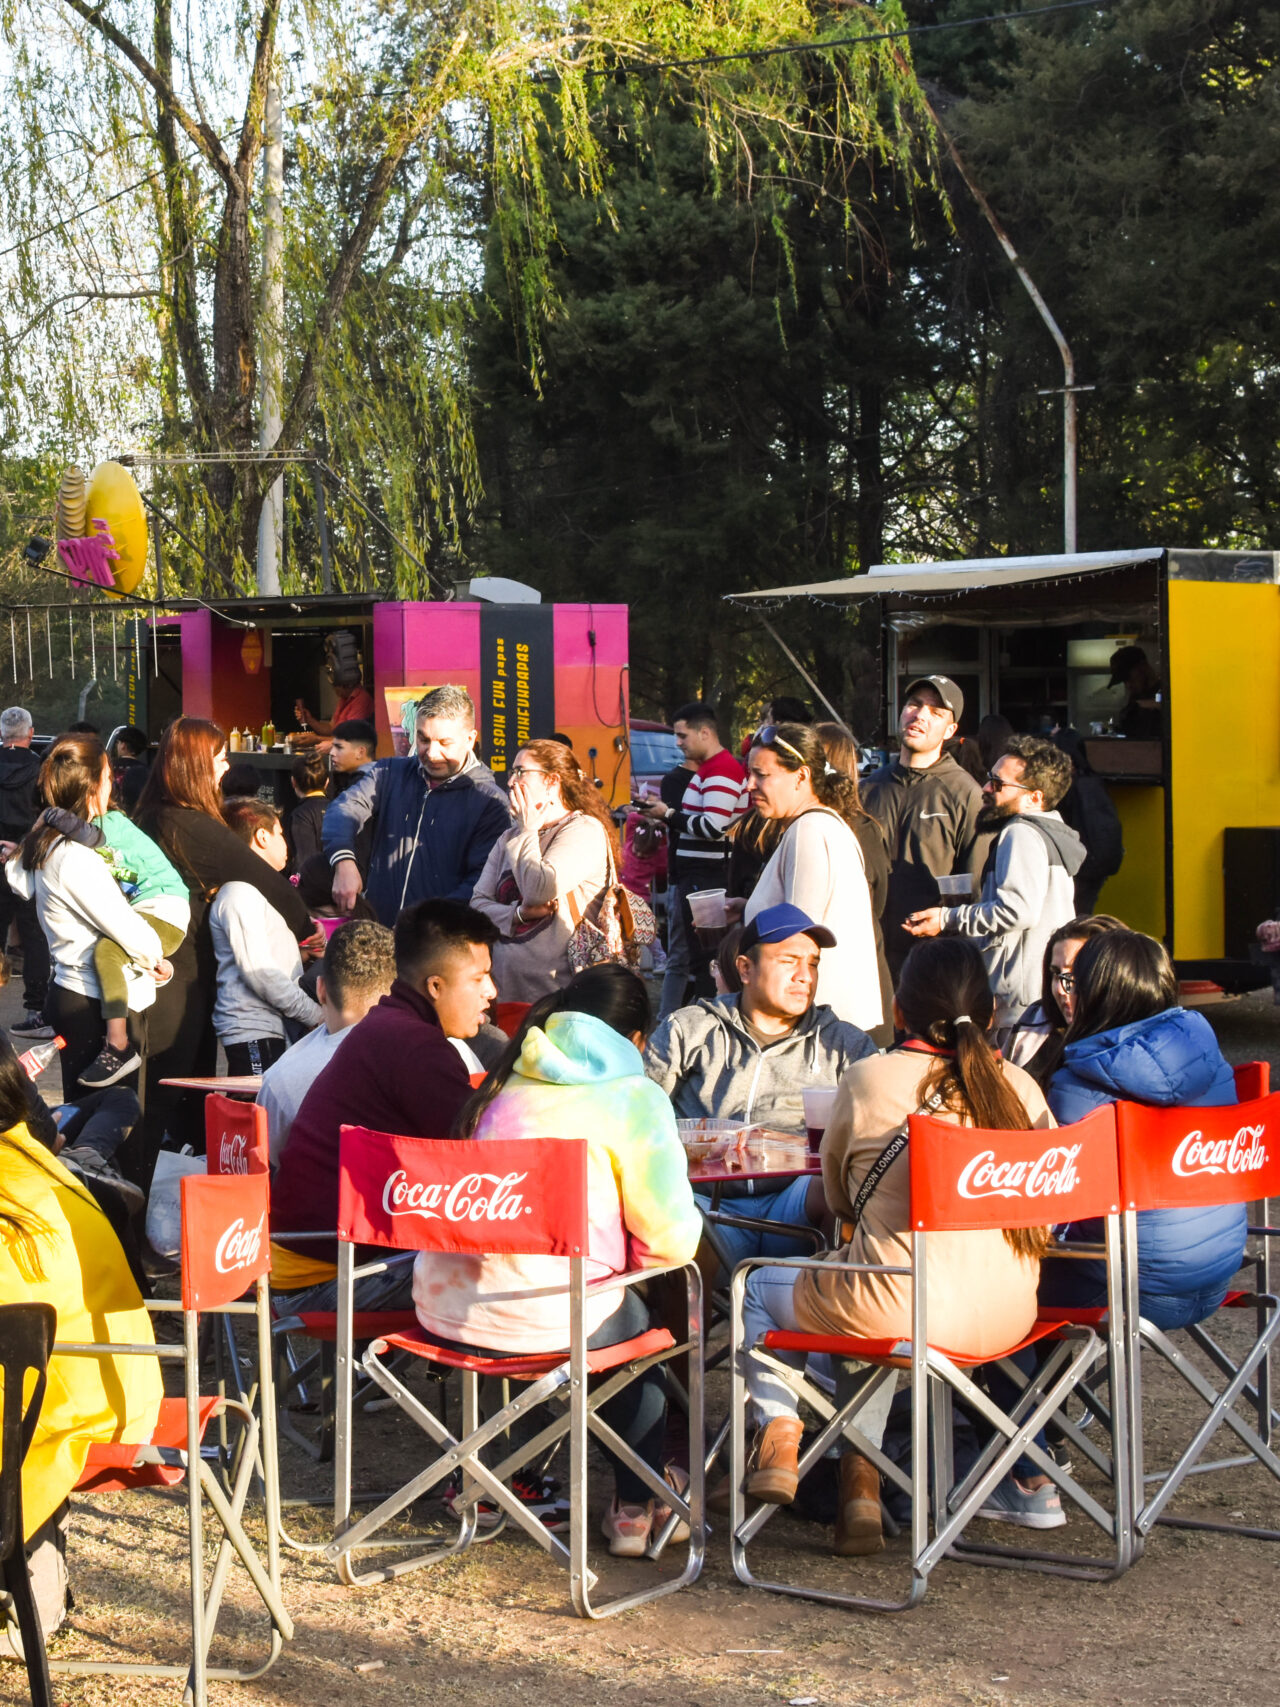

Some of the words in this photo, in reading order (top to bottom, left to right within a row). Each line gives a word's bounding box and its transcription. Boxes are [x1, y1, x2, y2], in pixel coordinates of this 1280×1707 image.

[496, 637, 507, 677] papas
[492, 680, 506, 708] FUN
[493, 713, 507, 747] SPIN
[876, 1137, 905, 1173] LONDON
[1172, 1124, 1266, 1177] Coca-Cola
[860, 1172, 879, 1204] LONDON
[957, 1143, 1083, 1199] Coca-Cola
[382, 1169, 529, 1222] Coca-Cola
